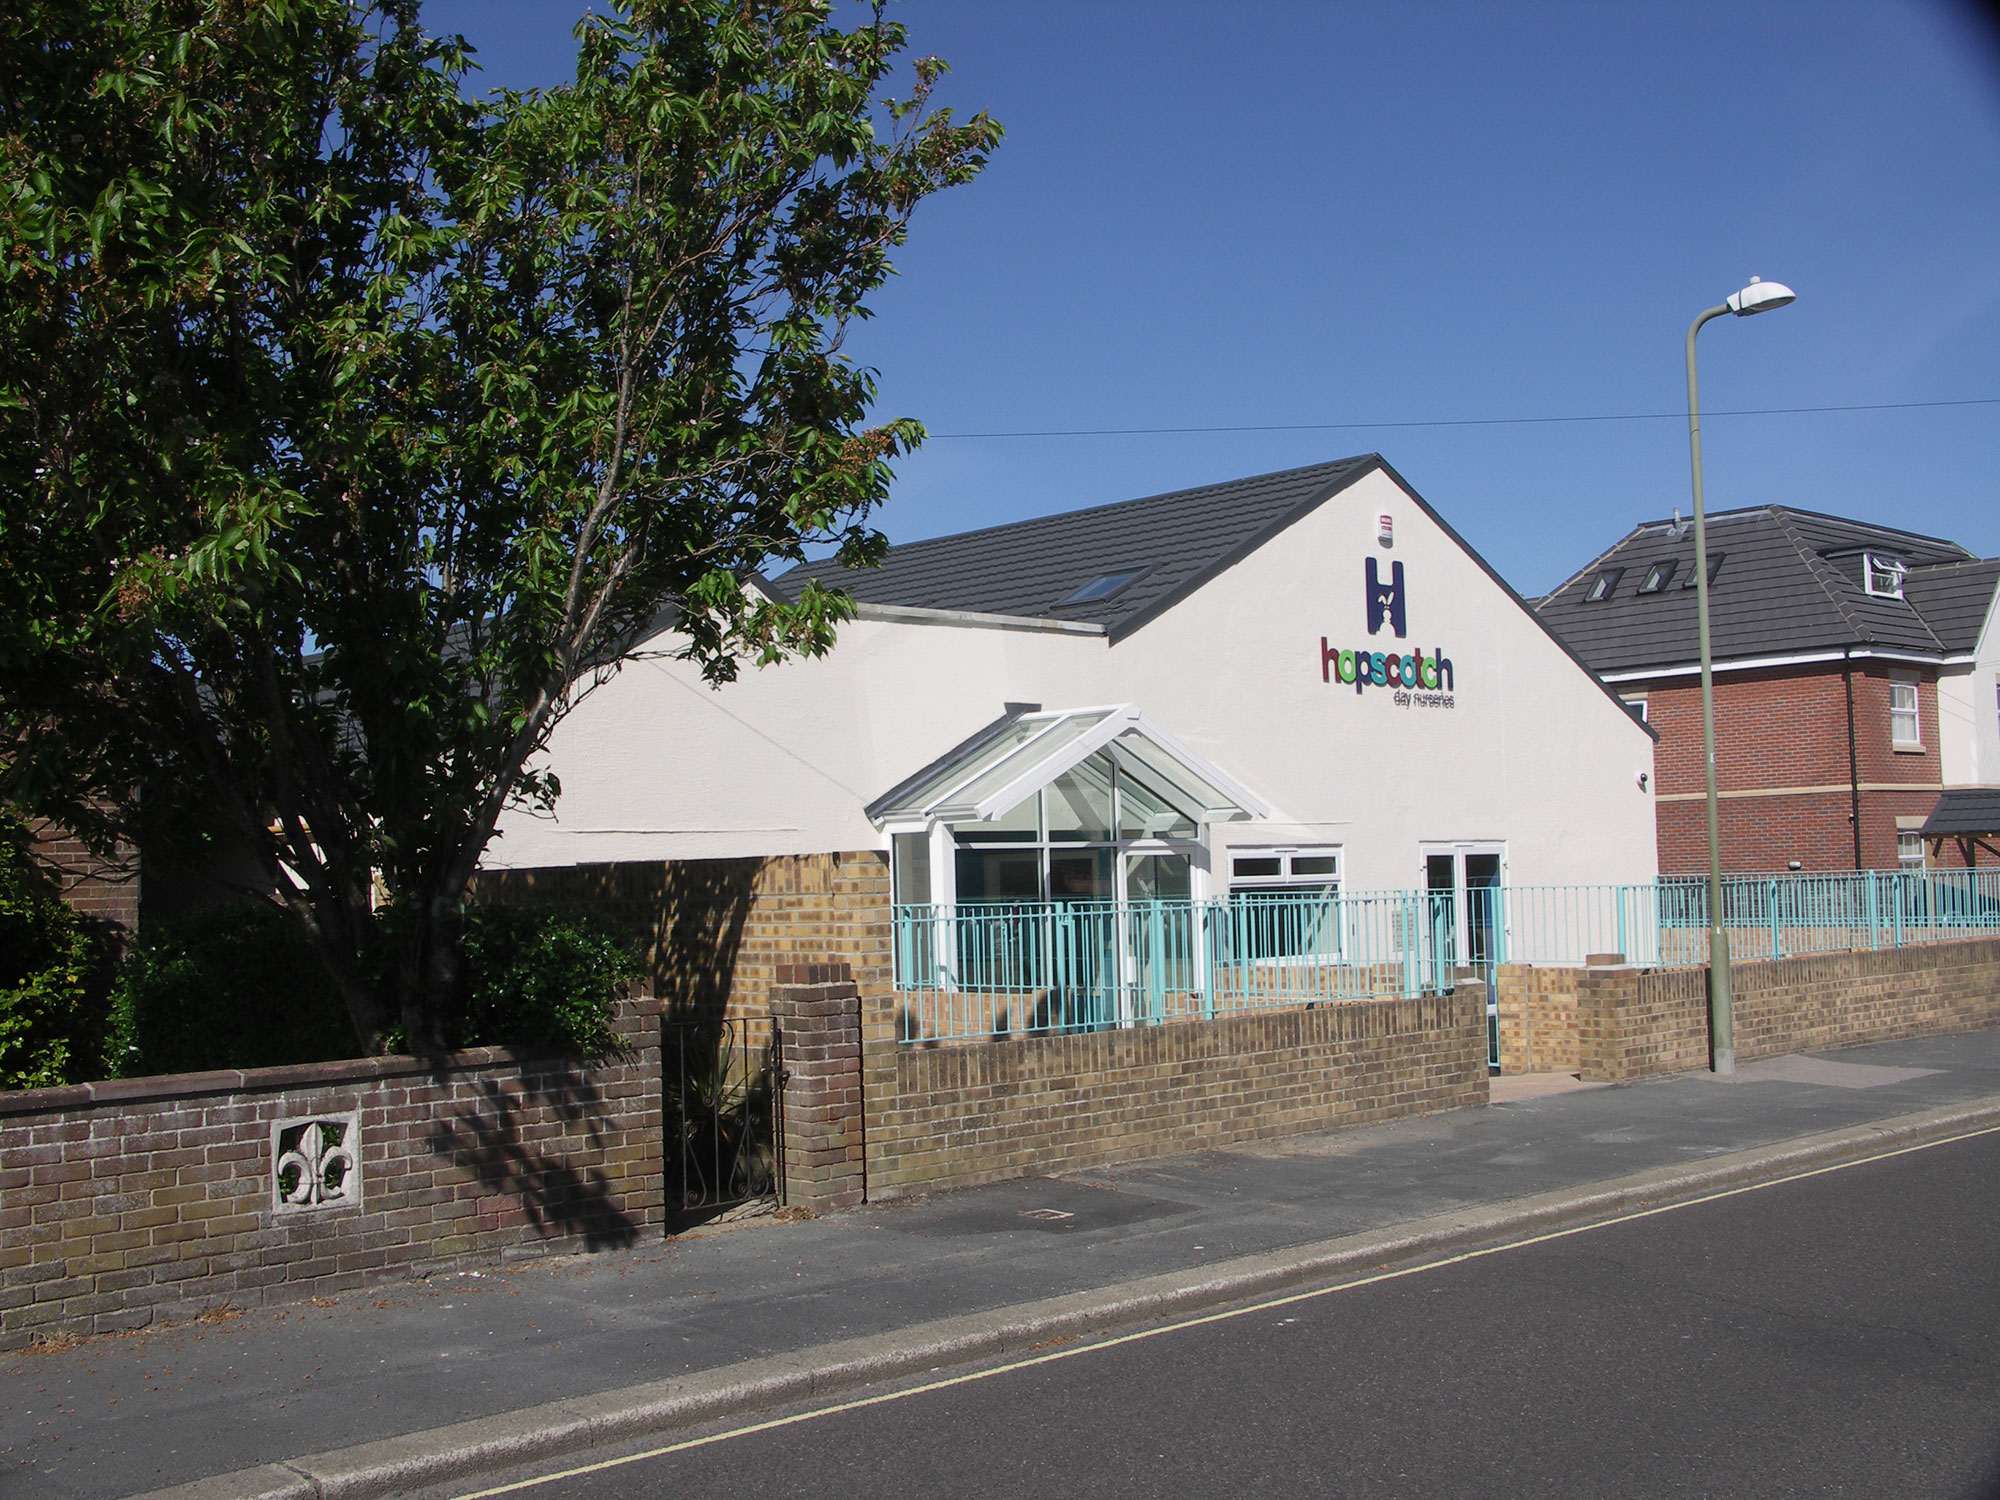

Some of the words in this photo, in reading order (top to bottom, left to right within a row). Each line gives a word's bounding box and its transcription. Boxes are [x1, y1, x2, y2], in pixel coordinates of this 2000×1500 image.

[1365, 557, 1406, 638] H
[1321, 637, 1453, 694] hopscotch
[1394, 690, 1411, 709] day
[1413, 692, 1455, 709] nurseries
